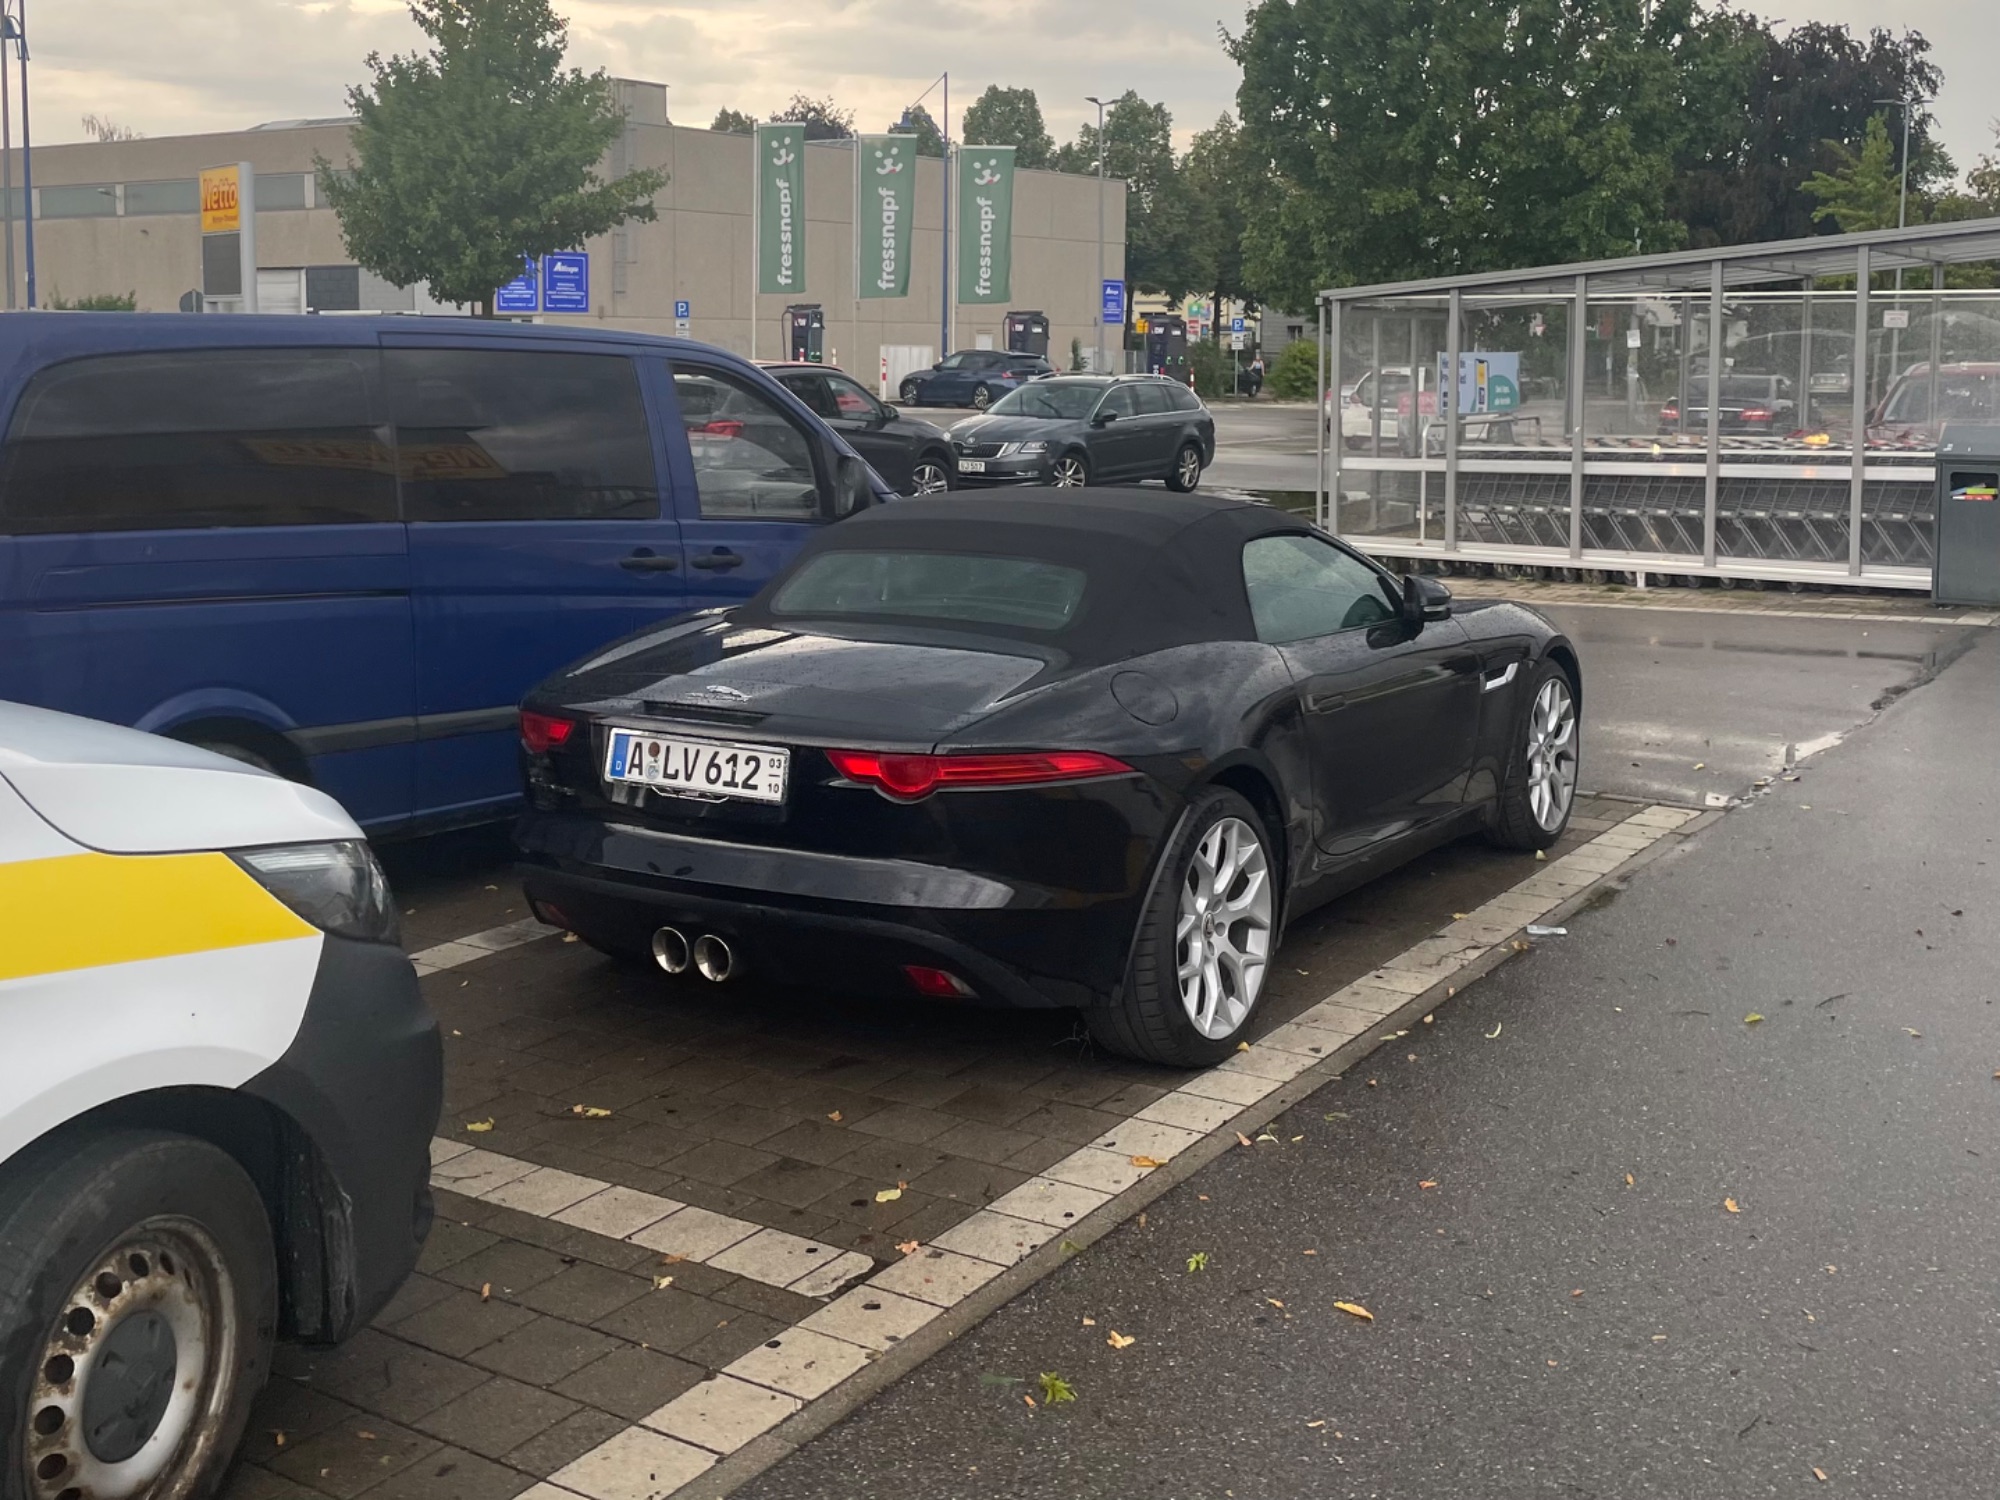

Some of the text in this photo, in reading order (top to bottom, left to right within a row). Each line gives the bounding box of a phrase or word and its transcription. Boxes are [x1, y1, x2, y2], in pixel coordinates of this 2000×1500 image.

[203, 177, 237, 211] Netto
[776, 178, 792, 286] fressnapf
[877, 187, 899, 290] fressnapf
[975, 196, 996, 296] fressnapf
[627, 741, 643, 776] A
[662, 745, 700, 782] LV
[705, 751, 761, 791] 612
[768, 757, 782, 769] 03
[768, 783, 780, 794] 10
